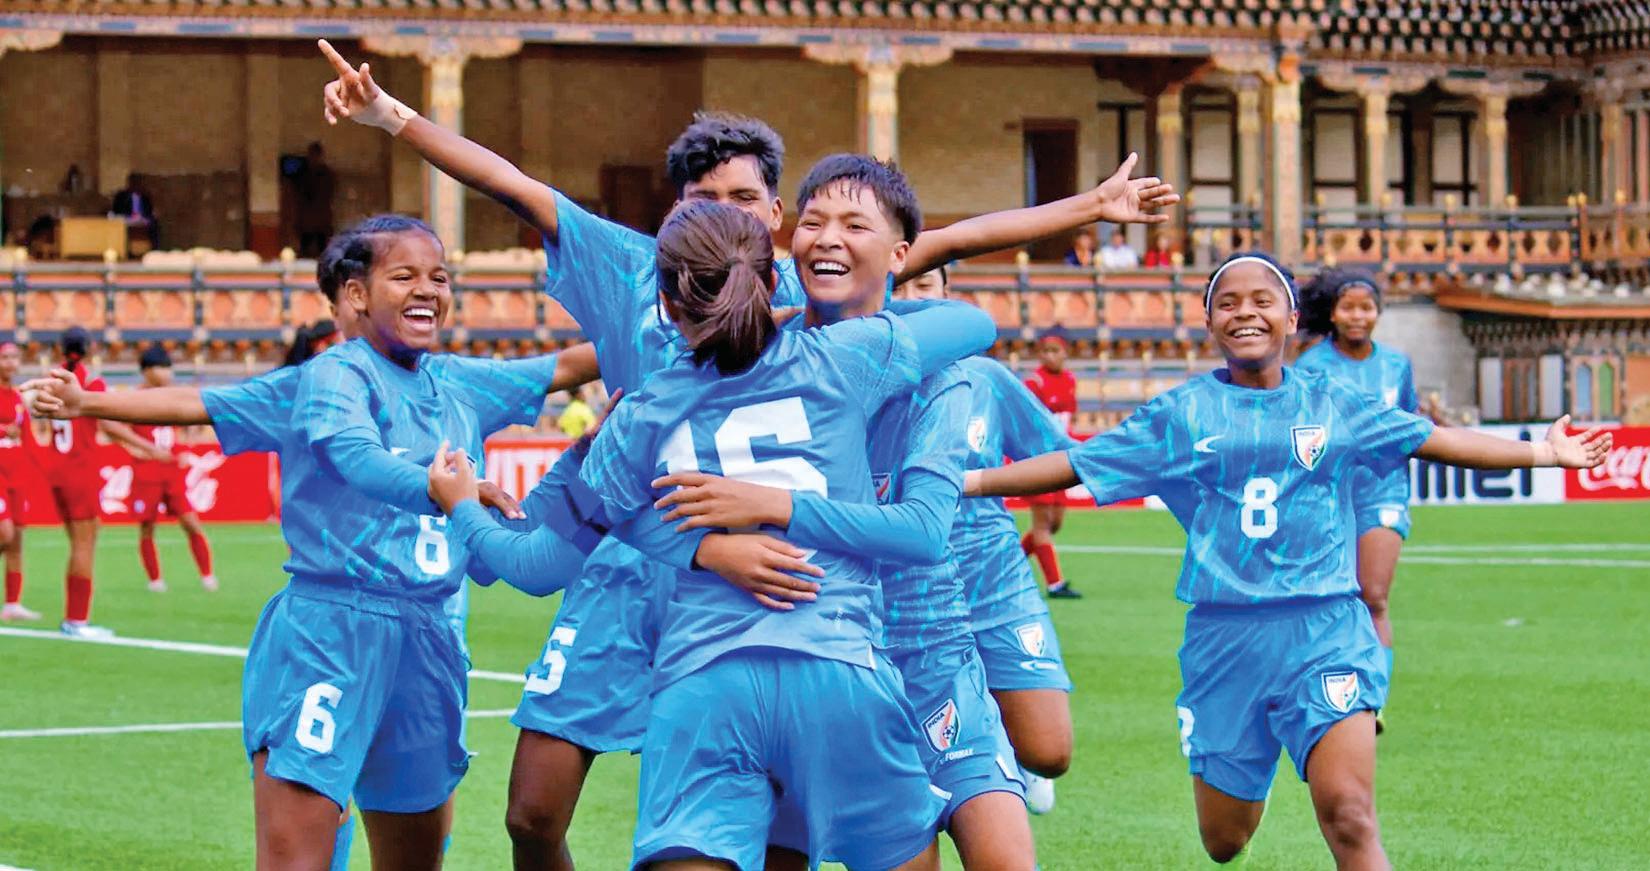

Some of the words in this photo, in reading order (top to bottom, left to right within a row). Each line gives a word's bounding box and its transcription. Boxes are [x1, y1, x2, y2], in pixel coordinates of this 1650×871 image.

[1241, 477, 1278, 538] 8
[414, 515, 450, 575] 6
[524, 626, 577, 695] 5
[295, 683, 343, 753] 6
[927, 712, 945, 729] INDIA
